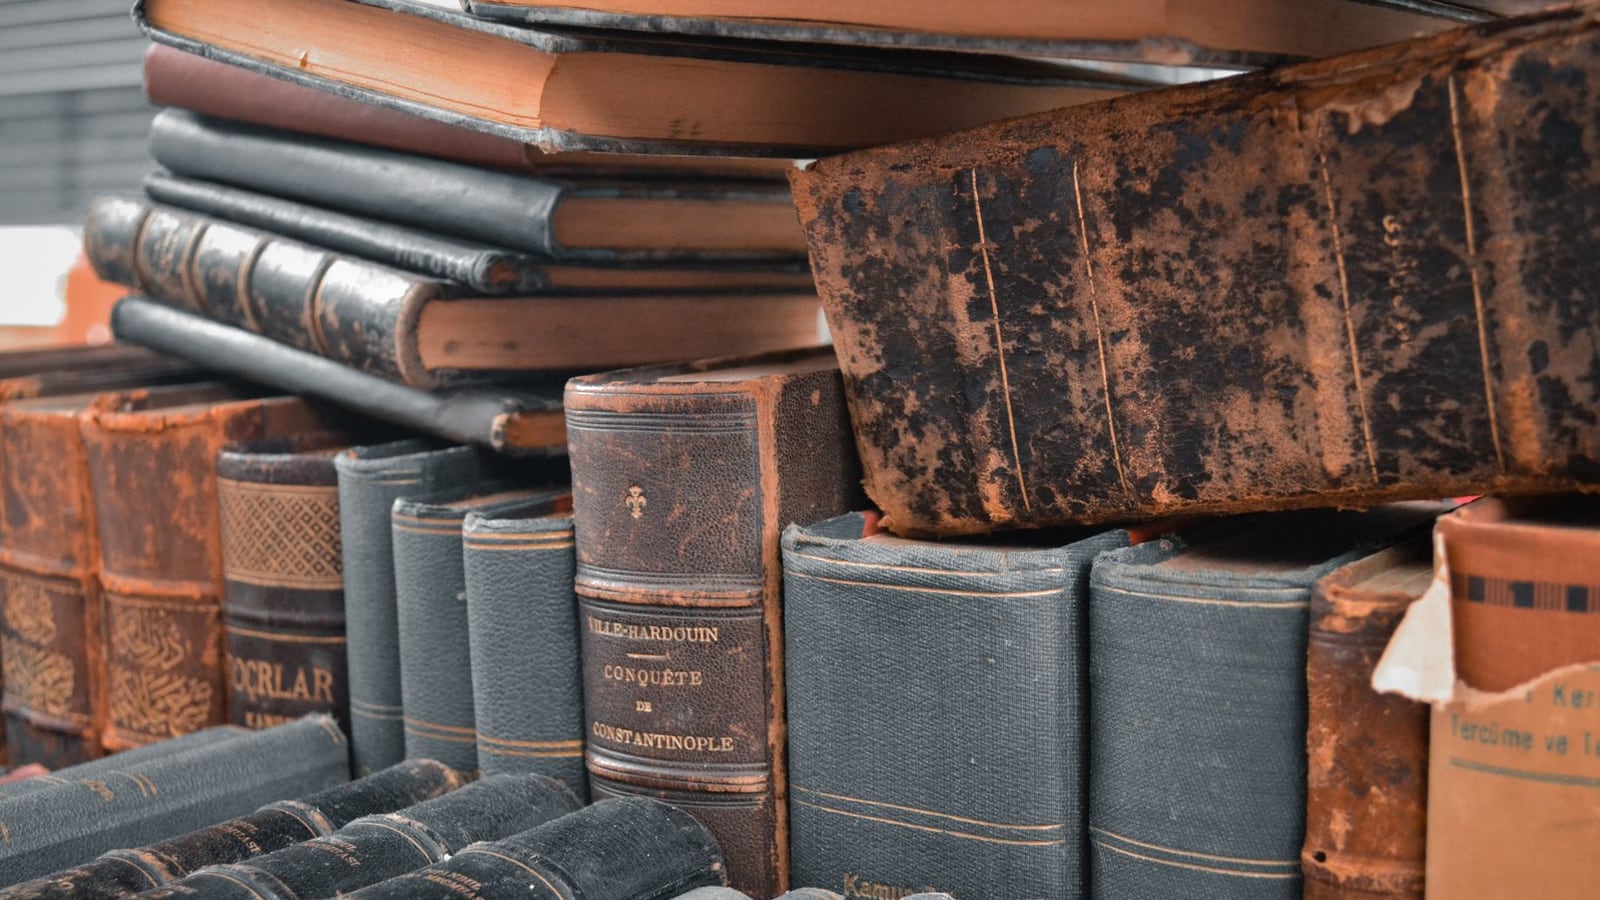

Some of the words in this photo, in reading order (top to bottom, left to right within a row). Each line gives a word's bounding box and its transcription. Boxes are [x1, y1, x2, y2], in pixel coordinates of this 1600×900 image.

[588, 615, 719, 642] VILLE-HARDOUIN
[604, 664, 702, 686] CONQUÊTE
[635, 700, 652, 713] DE
[1553, 683, 1600, 708] Ker
[592, 721, 734, 752] CONSTANTINOPLE
[1545, 735, 1568, 755] ve
